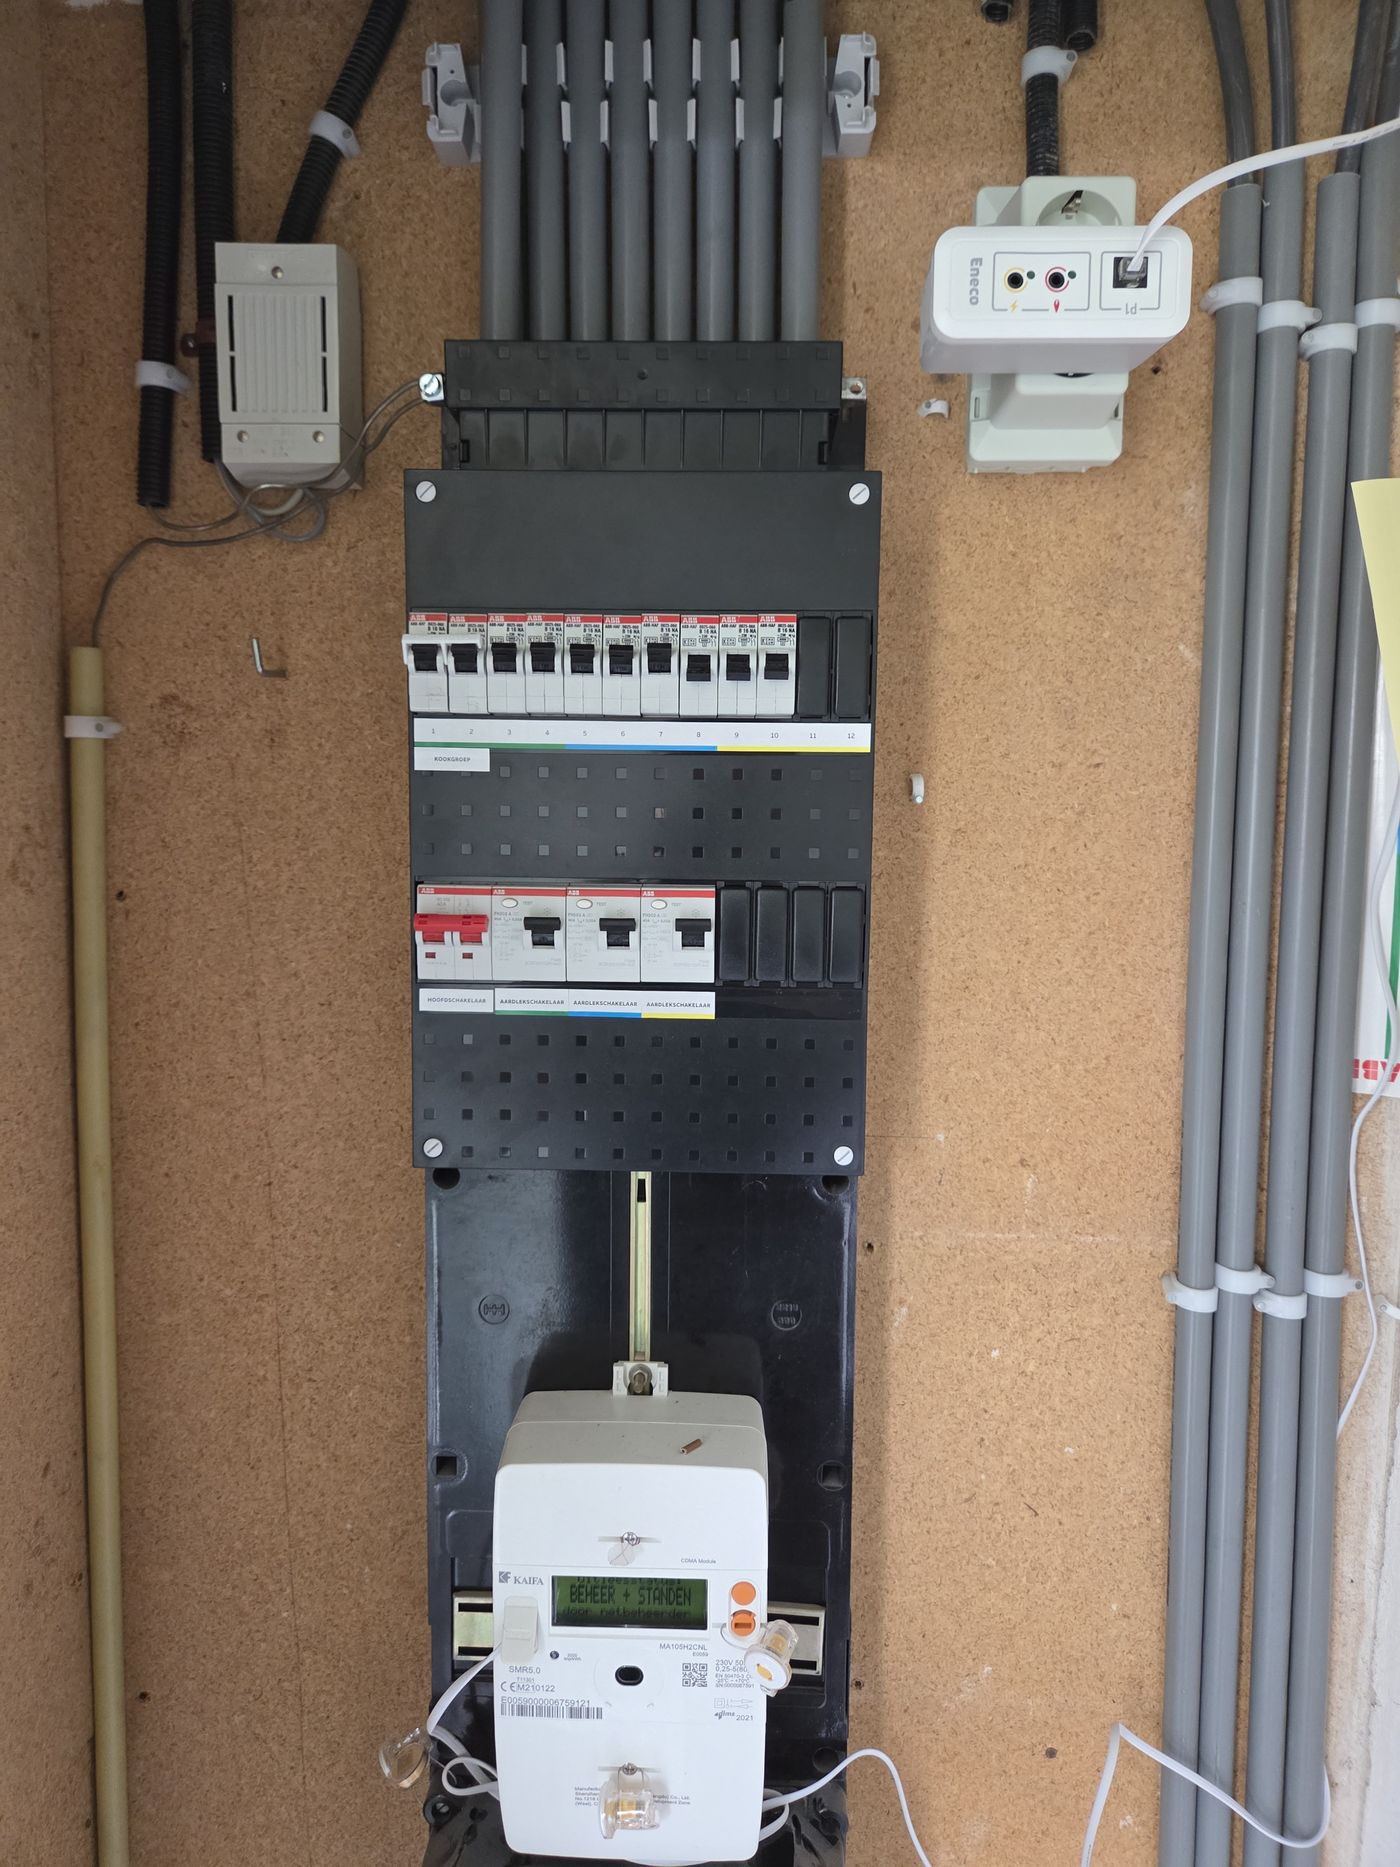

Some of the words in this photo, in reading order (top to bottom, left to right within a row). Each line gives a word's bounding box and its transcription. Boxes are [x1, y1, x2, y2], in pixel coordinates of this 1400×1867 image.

[968, 257, 982, 306] Eneco
[514, 1576, 544, 1586] KAIFA
[570, 1584, 616, 1604] BEHEER
[622, 1587, 630, 1602] +
[638, 1586, 691, 1606] STANDEN
[660, 1643, 708, 1651] MA105H2CNL
